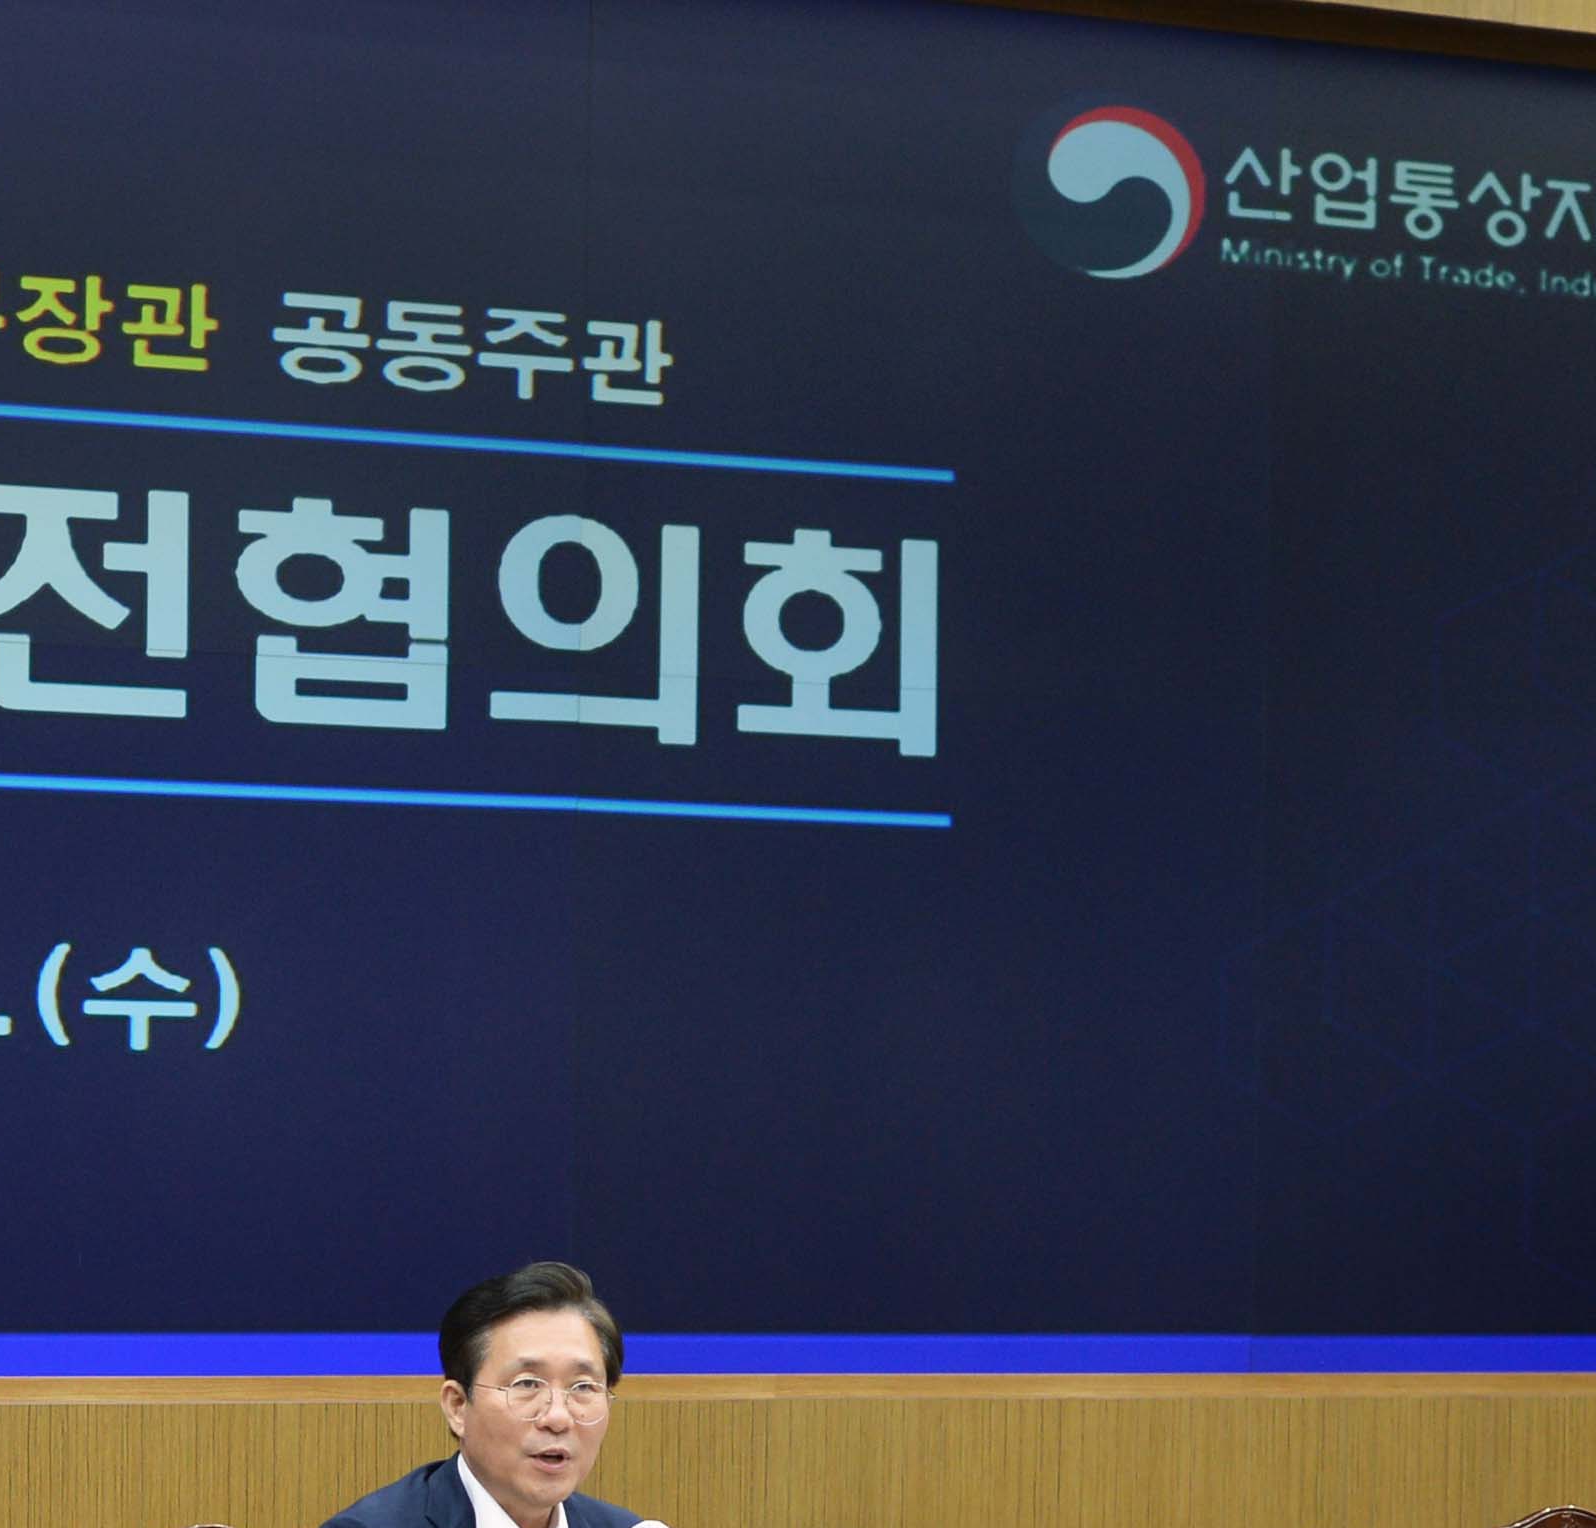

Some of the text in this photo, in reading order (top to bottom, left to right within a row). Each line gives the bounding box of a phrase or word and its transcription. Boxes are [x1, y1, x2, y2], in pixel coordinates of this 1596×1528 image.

[1220, 237, 1356, 280] Ministry
[1369, 253, 1404, 279] of
[1420, 256, 1526, 295] Trade,
[272, 292, 673, 406] 공동주관
